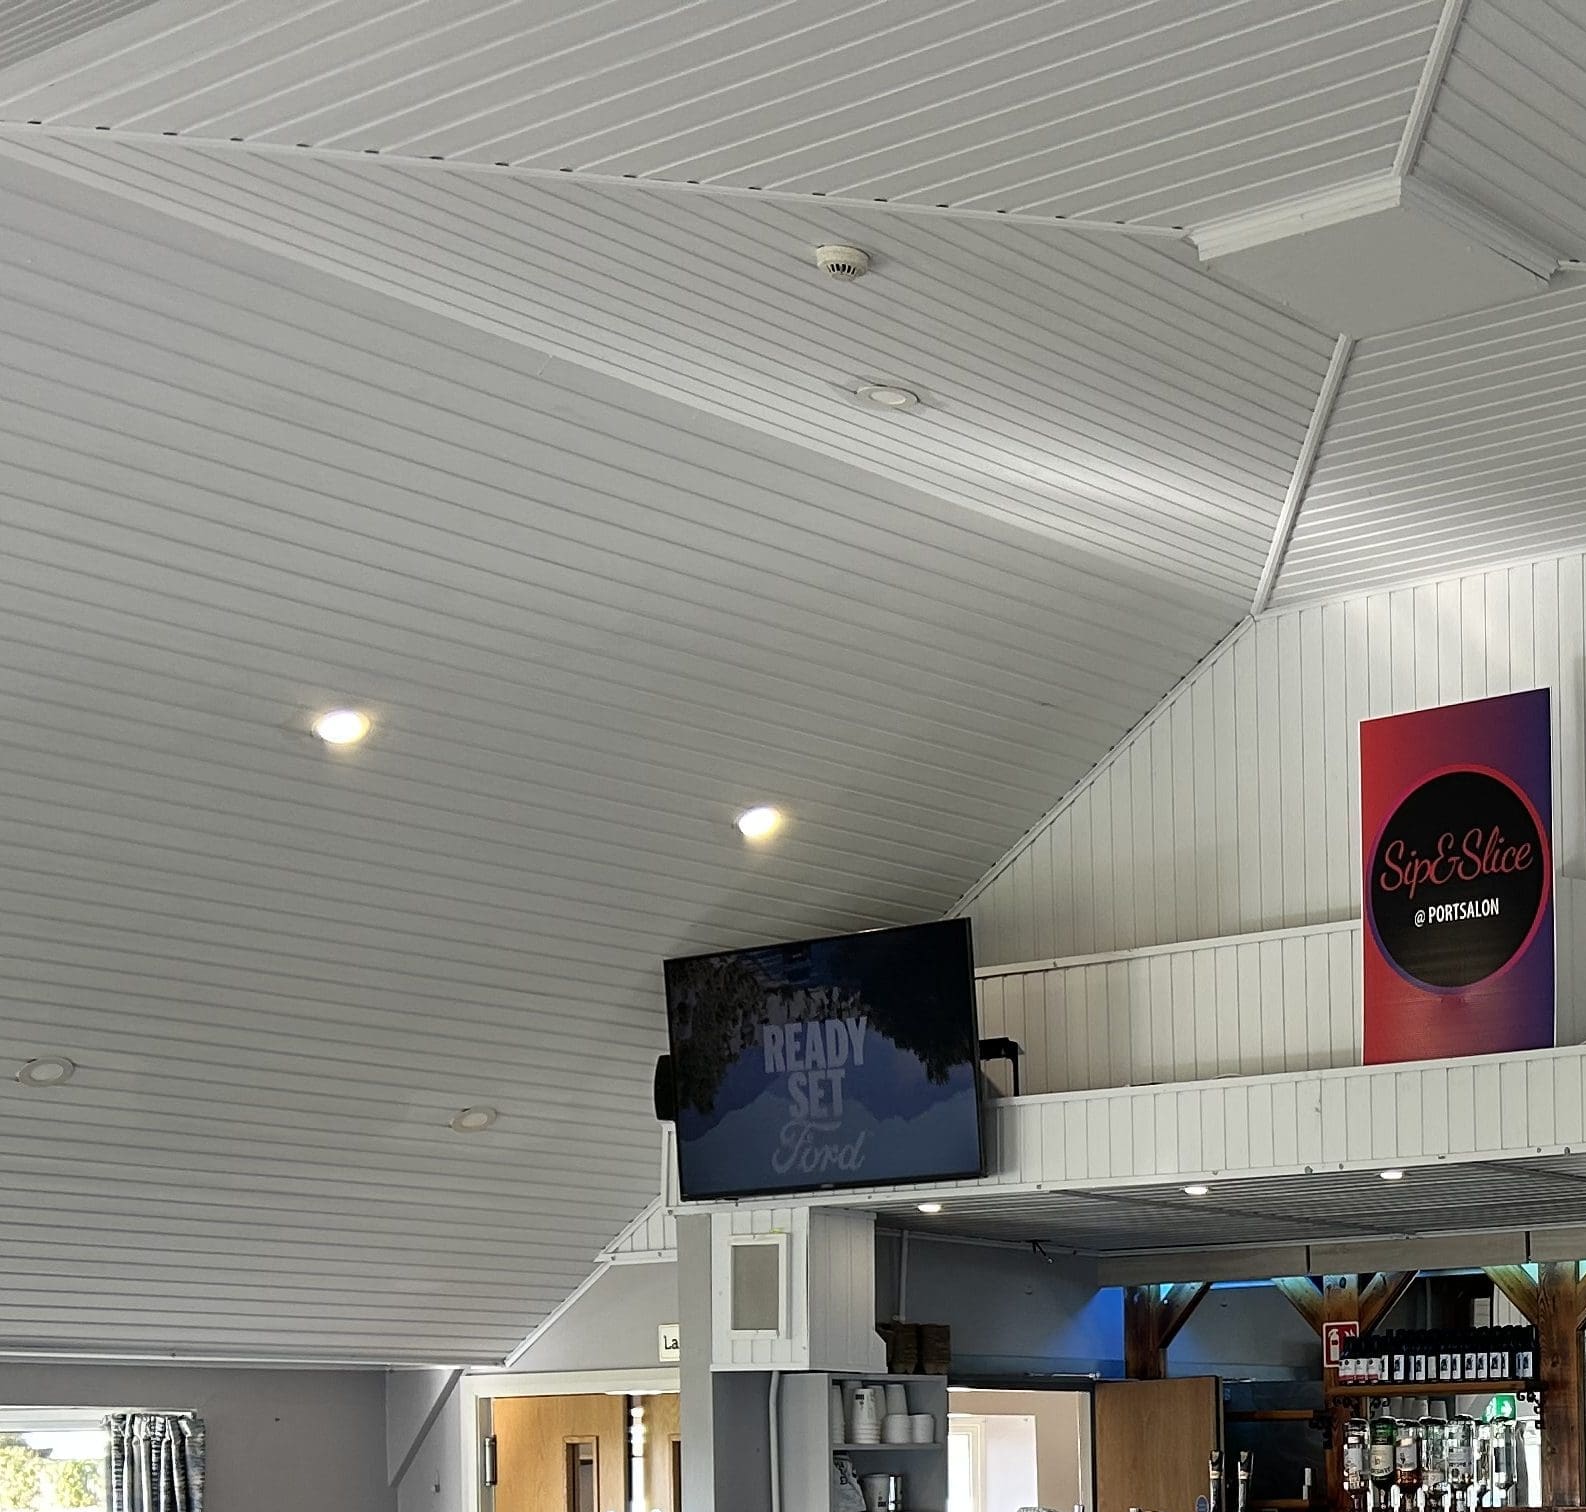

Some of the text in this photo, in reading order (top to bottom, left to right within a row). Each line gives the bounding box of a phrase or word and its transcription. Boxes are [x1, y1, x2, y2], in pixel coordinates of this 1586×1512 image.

[1380, 825, 1533, 899] Sip&Slice
[1414, 897, 1500, 927] @ PORTSALON
[763, 1015, 868, 1074] READY
[788, 1068, 846, 1121] SET
[772, 1120, 868, 1174] Ford
